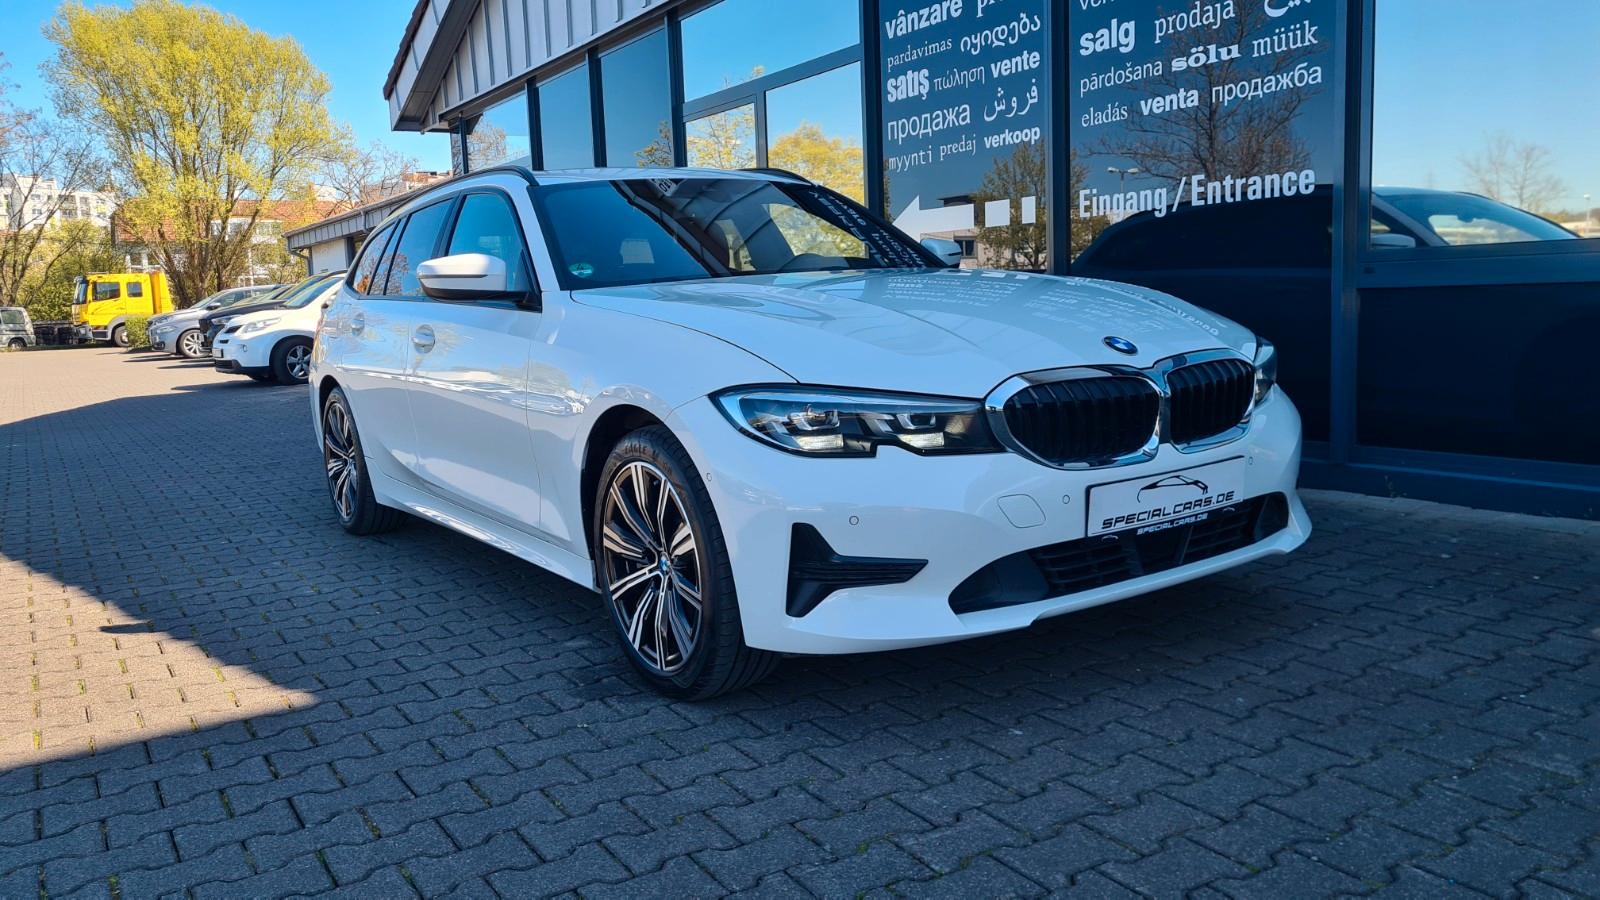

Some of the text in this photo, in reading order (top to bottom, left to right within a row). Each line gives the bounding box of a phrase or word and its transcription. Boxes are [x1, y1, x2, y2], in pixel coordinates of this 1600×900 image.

[885, 0, 963, 39] vânzare
[960, 12, 1041, 55] იყიდება
[1079, 18, 1136, 56] salg
[1154, 0, 1236, 44] prodaja
[887, 38, 953, 72] pardavimas
[990, 50, 1041, 79] vente
[1080, 20, 1319, 97] pārdošana sölu müük
[887, 68, 930, 102] satış
[933, 66, 985, 92] πώληση
[1211, 62, 1323, 106] продажба
[983, 78, 1039, 122] فروش
[1081, 87, 1199, 128] eladás venta
[887, 104, 971, 145] продажа
[888, 126, 1041, 173] myynti predaj verkoop
[1079, 168, 1316, 218] Eingang / Entrance
[1101, 490, 1235, 530] SPECIALCARS.DE
